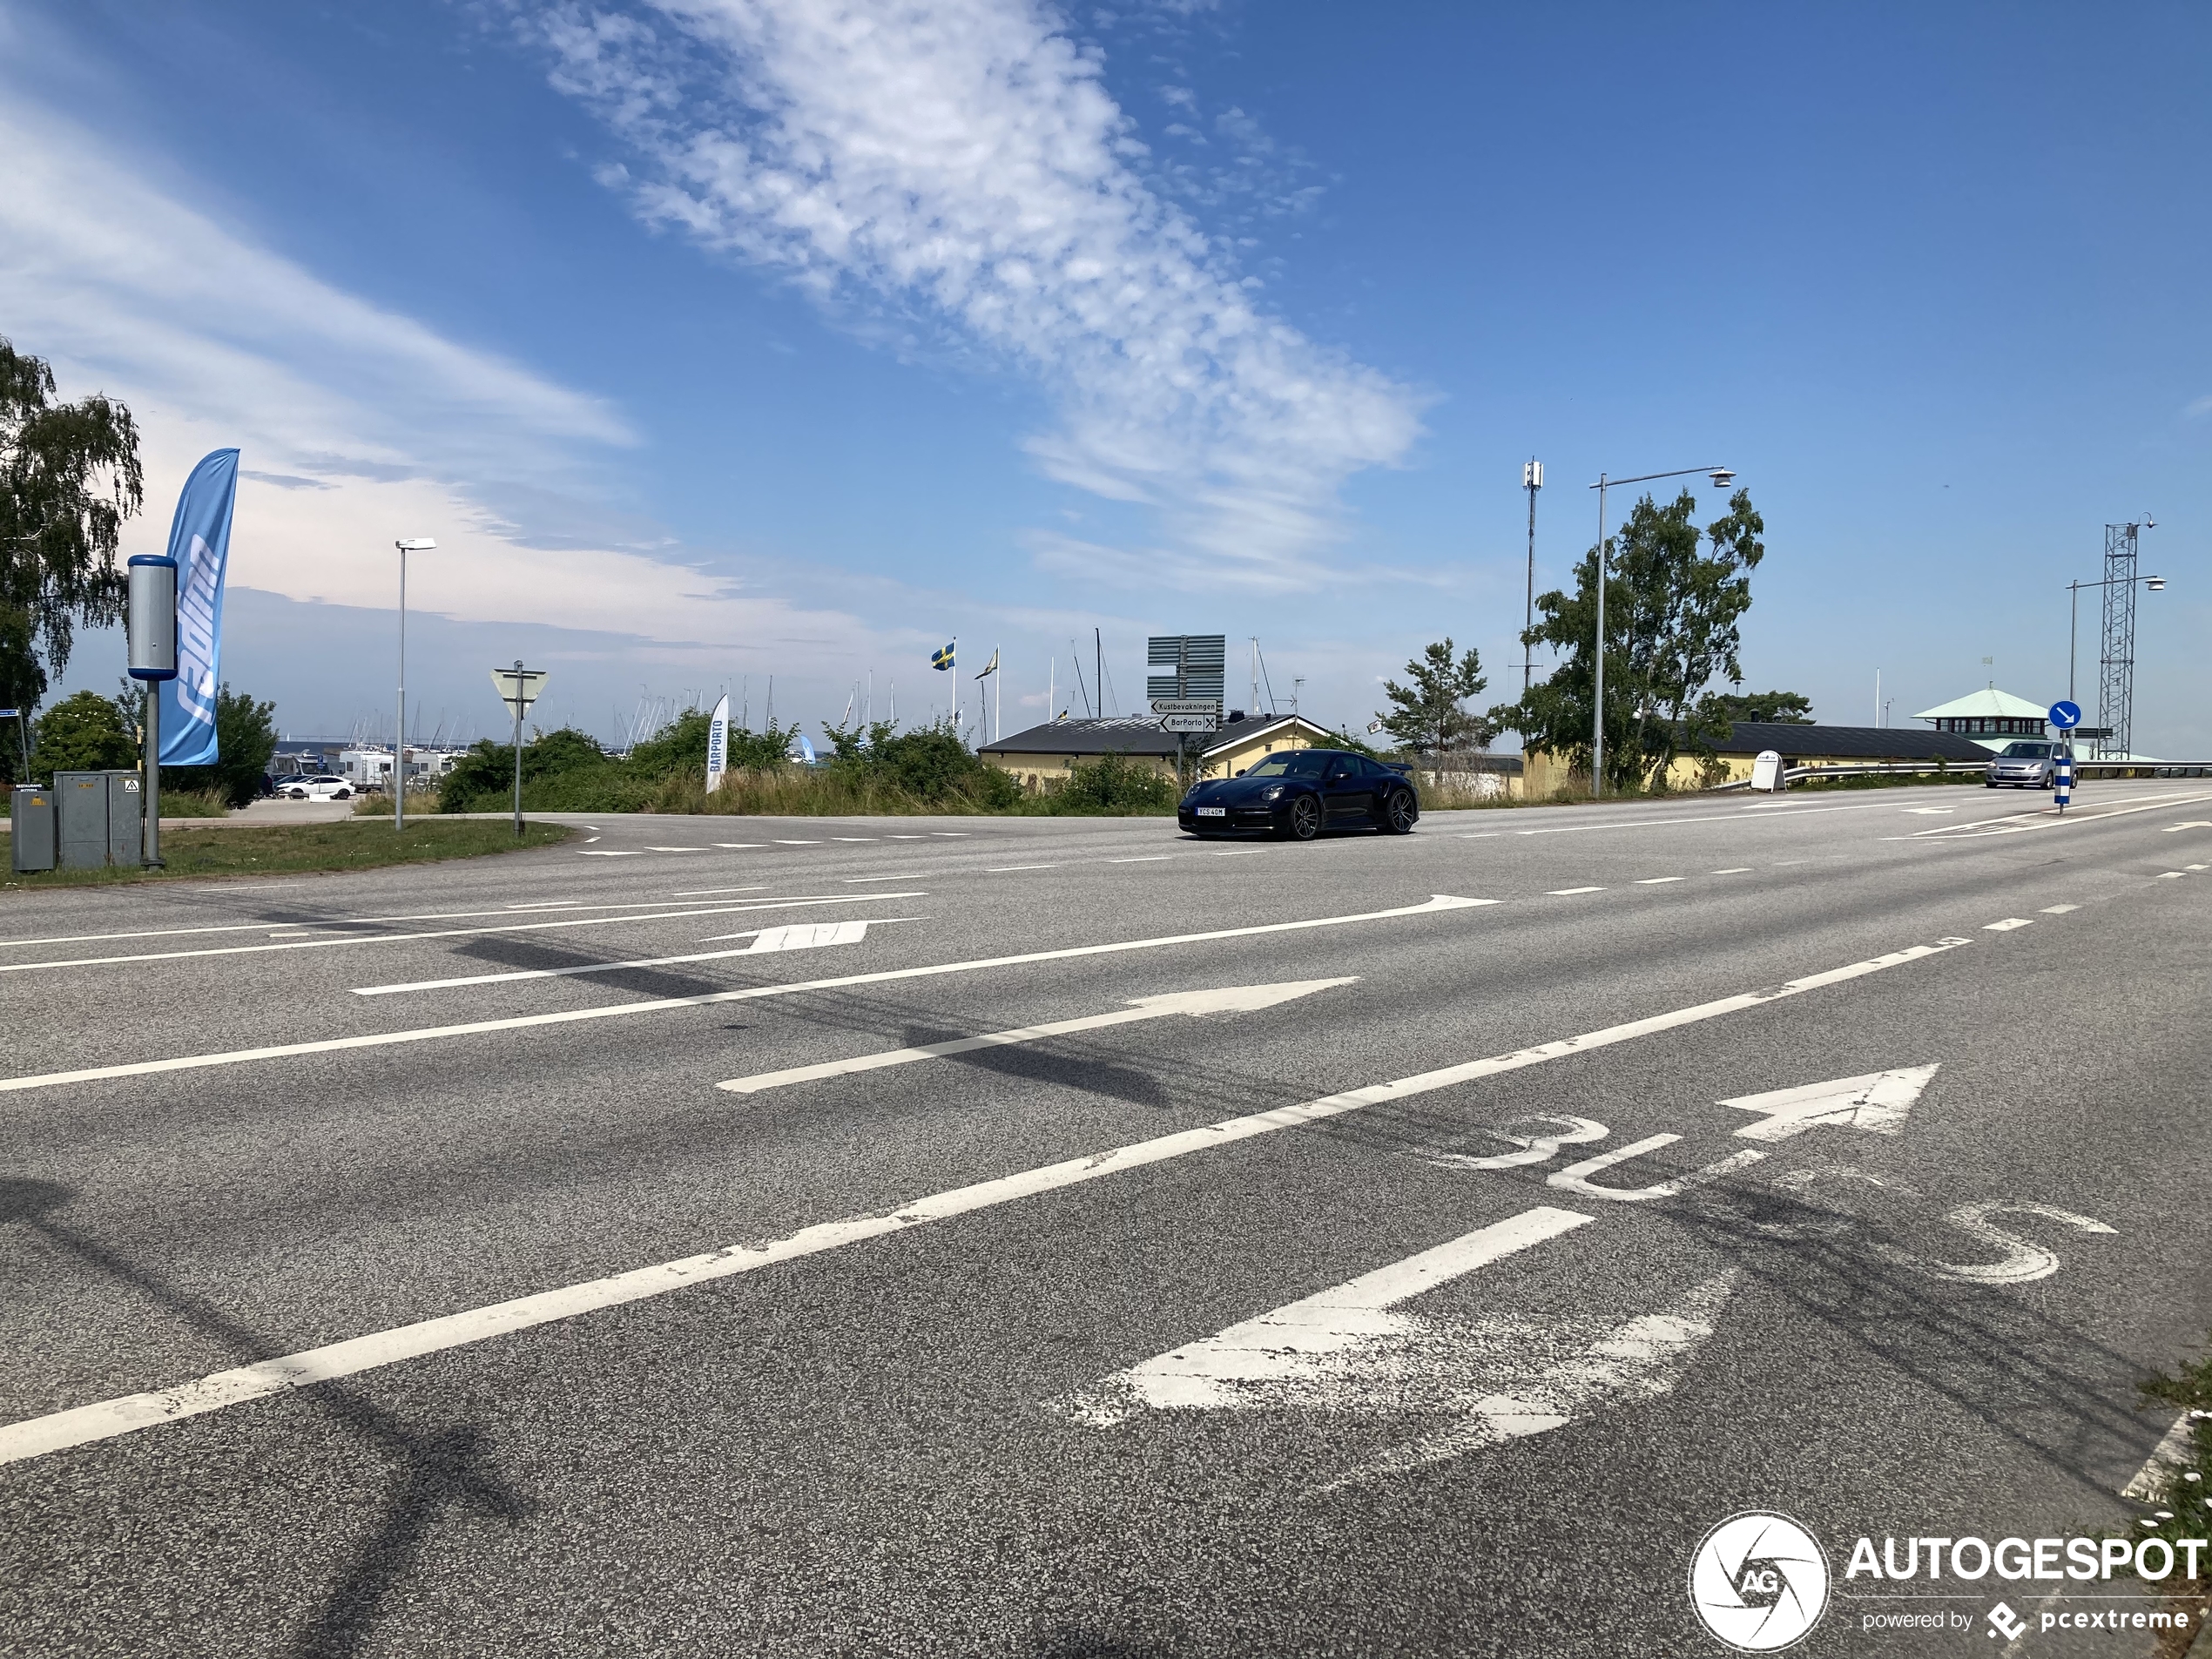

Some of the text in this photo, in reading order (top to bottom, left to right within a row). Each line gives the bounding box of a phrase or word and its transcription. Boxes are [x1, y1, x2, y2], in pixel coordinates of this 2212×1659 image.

[177, 533, 219, 726] radinn
[1159, 703, 1215, 711] Kustbevakningen
[710, 720, 723, 772] BARPORTO
